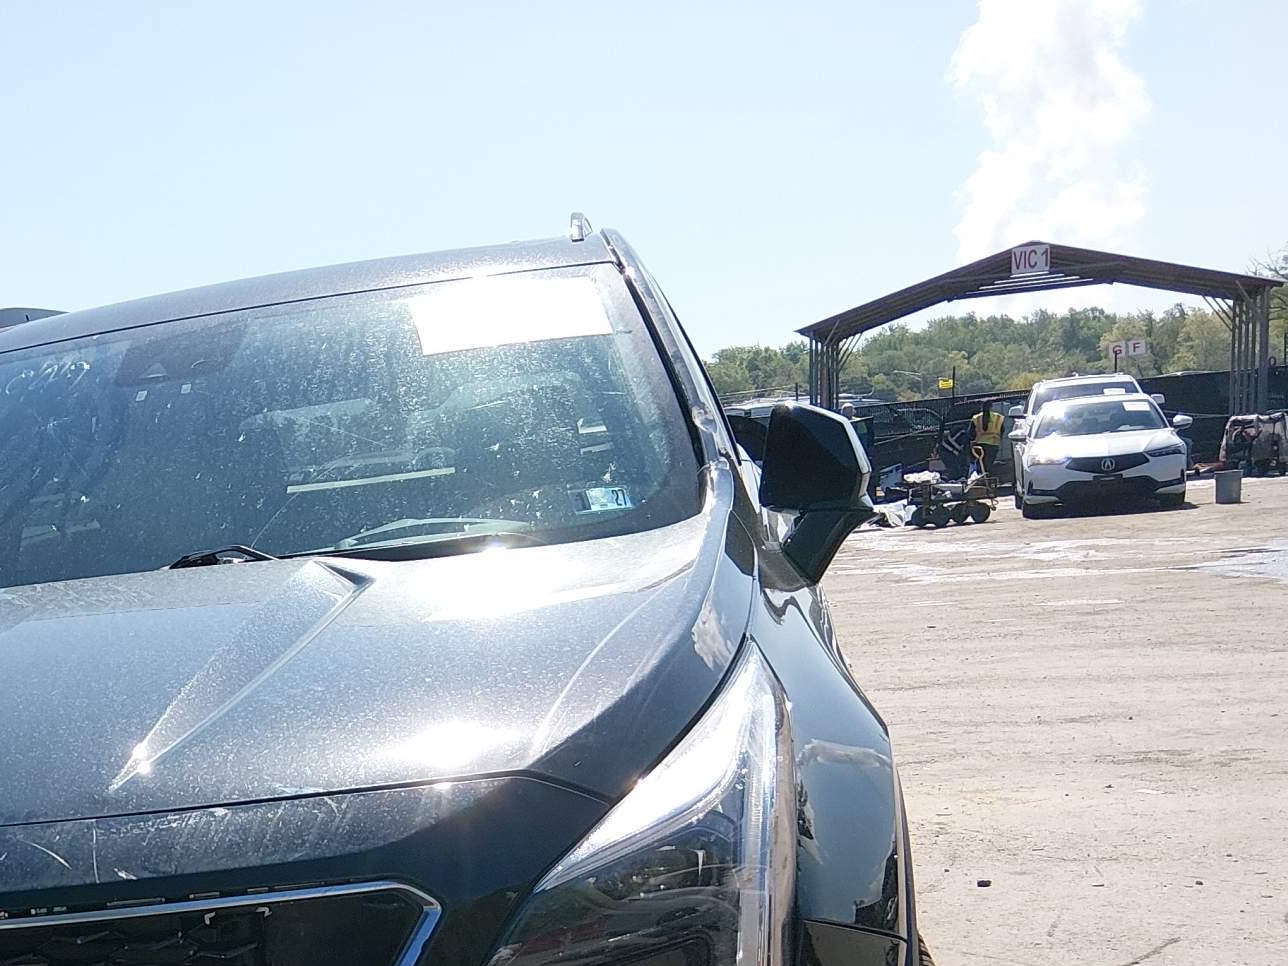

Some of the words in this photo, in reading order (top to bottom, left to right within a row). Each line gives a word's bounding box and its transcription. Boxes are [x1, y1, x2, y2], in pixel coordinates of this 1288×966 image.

[1013, 249, 1038, 270] VIC
[1041, 247, 1049, 267] 1
[1133, 342, 1141, 353] F
[611, 489, 627, 506] 27
